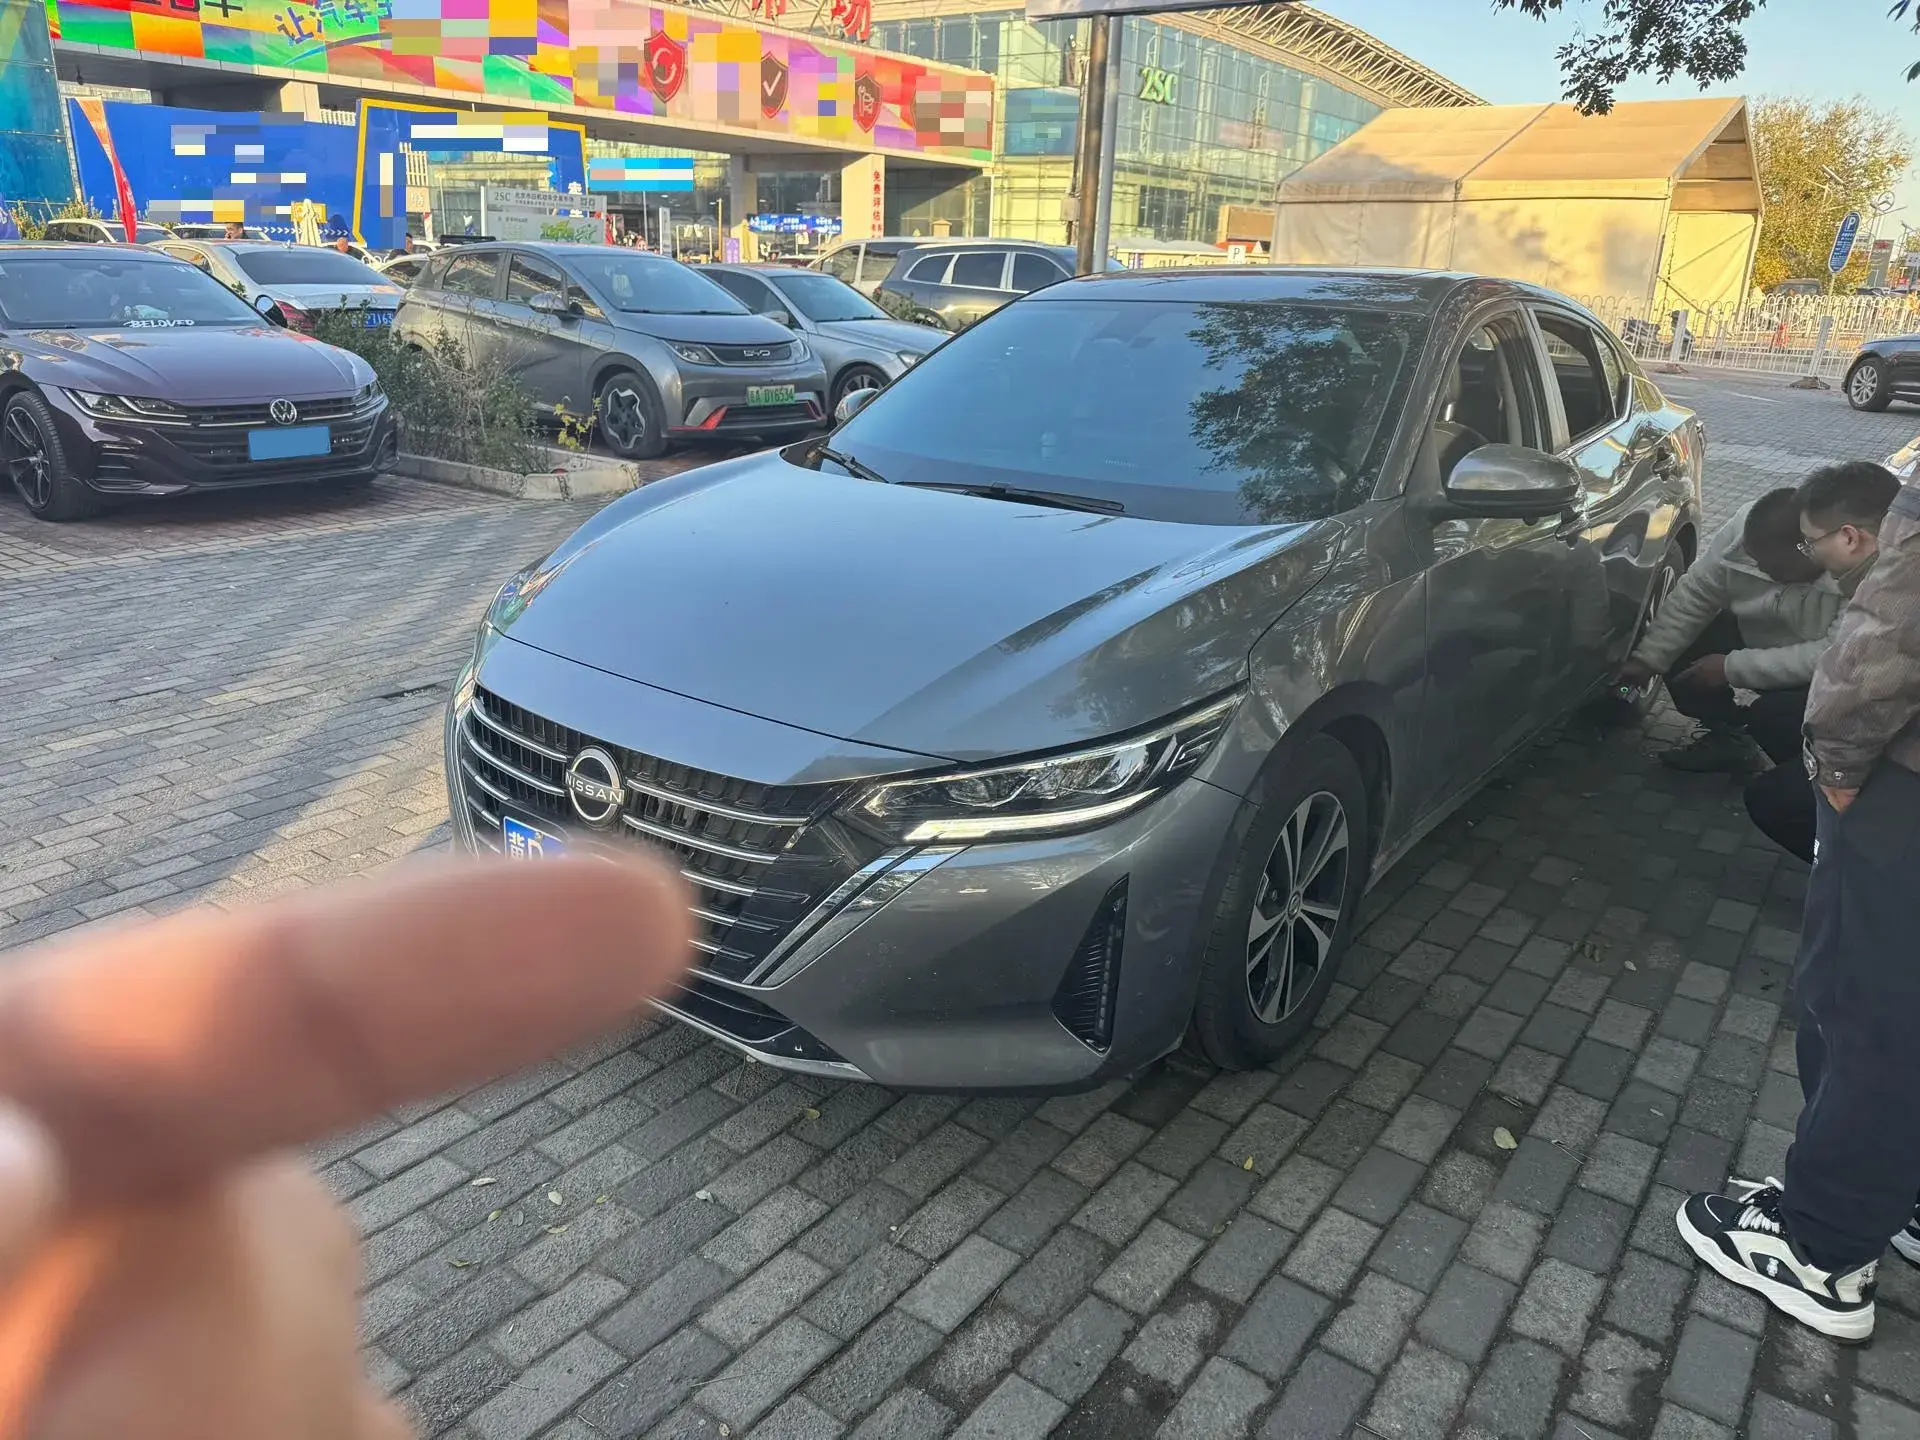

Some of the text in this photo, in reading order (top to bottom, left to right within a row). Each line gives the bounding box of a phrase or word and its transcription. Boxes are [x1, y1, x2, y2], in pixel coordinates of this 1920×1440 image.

[1138, 66, 1178, 104] 2SC
[494, 191, 511, 202] 2SC
[565, 771, 622, 803] NISSAN
